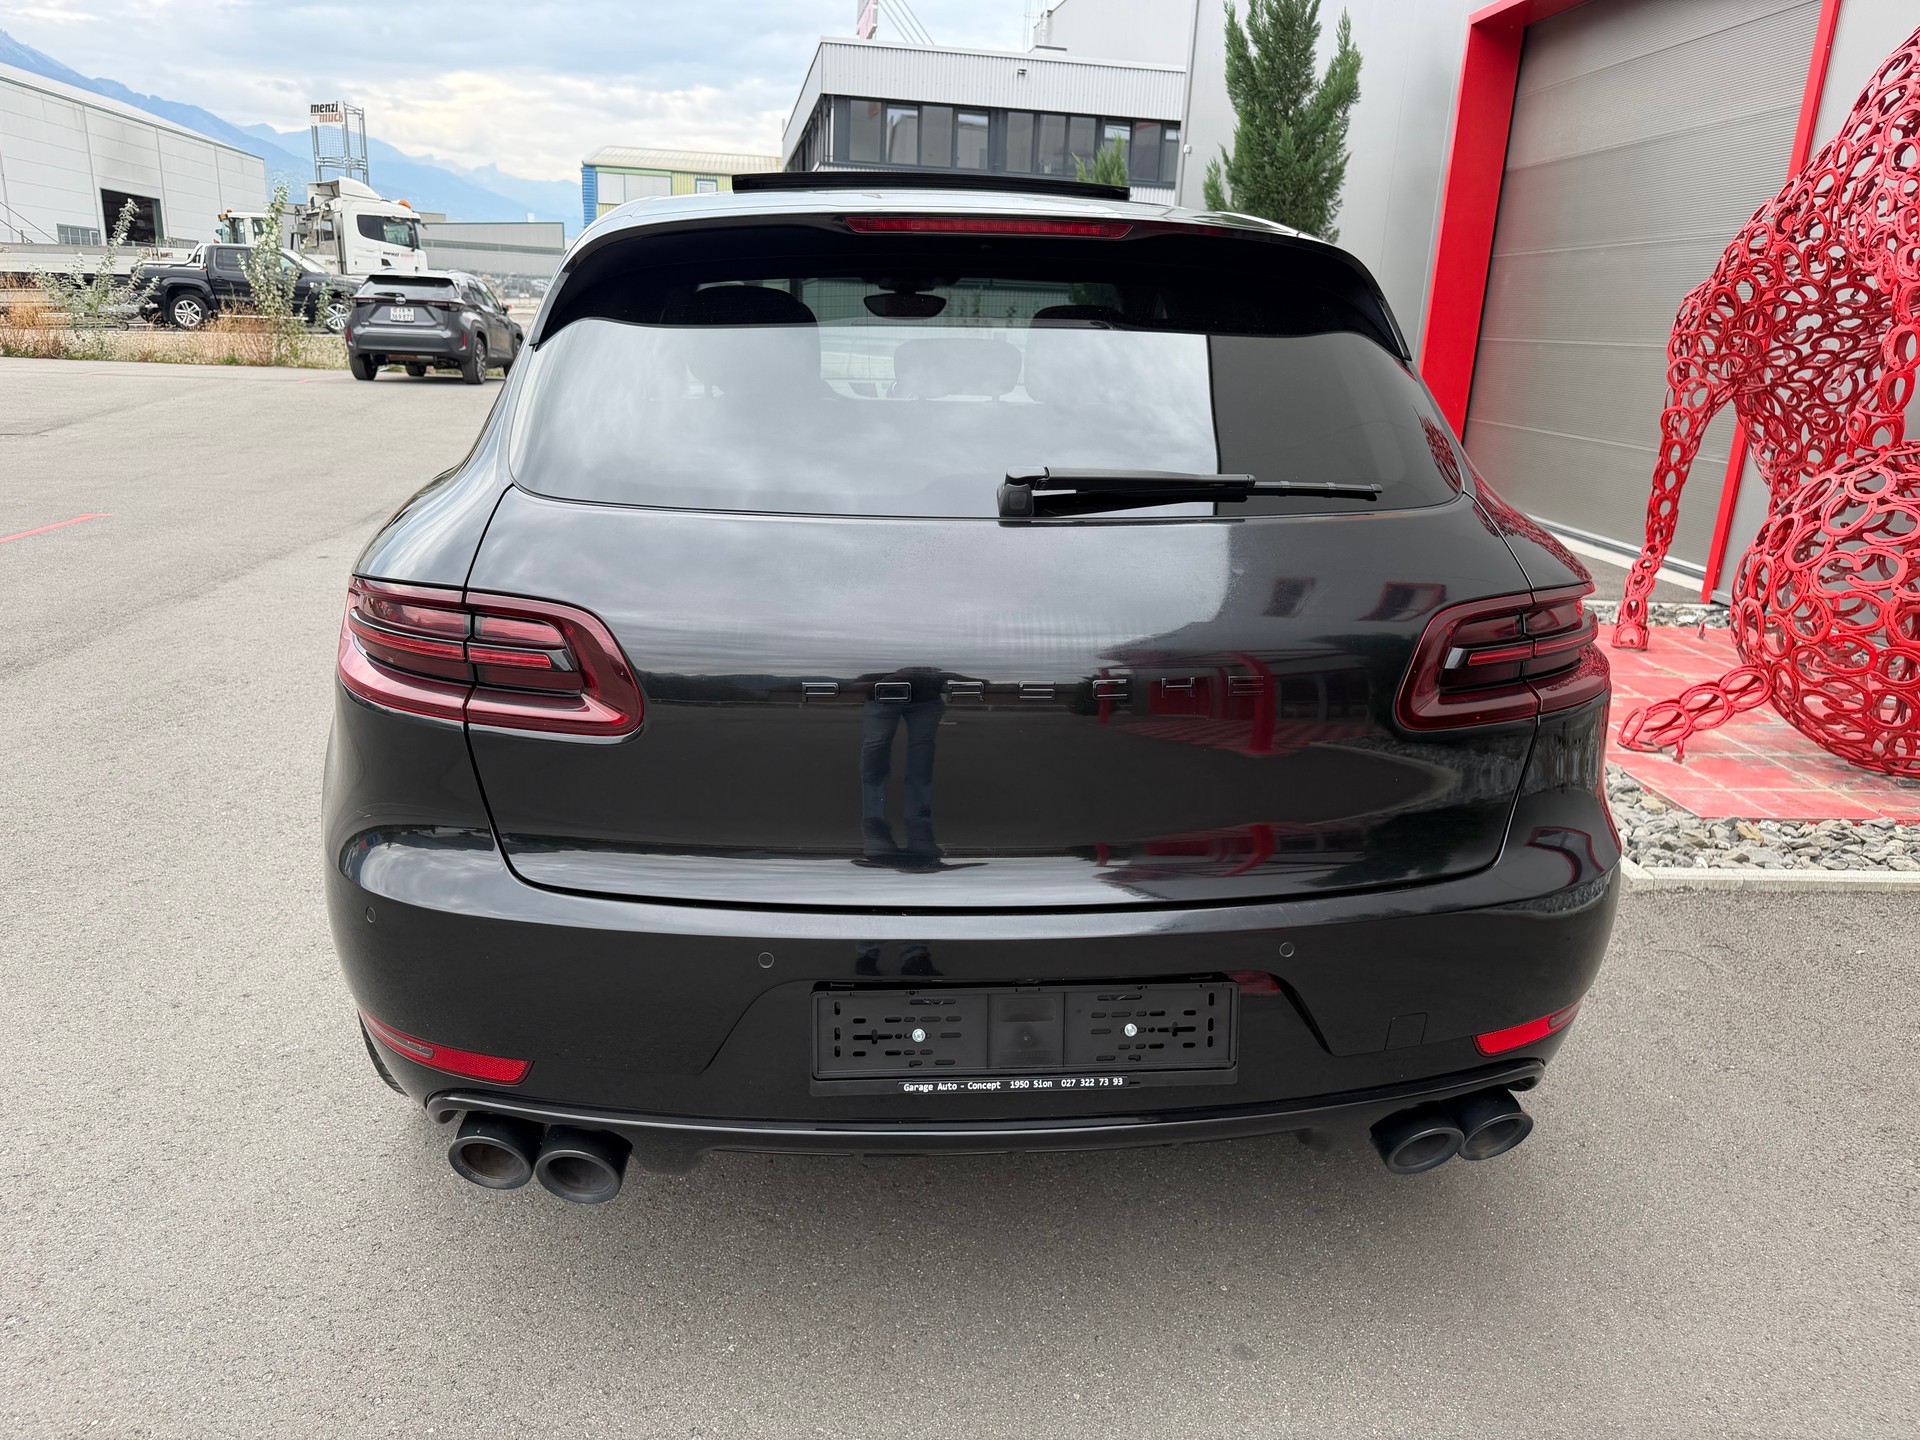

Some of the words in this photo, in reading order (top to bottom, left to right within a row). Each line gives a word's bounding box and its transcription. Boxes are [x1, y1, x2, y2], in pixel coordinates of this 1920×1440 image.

[310, 100, 339, 114] menzi
[319, 110, 344, 123] muck
[801, 675, 1265, 703] PORSCHE
[903, 1083, 934, 1093] Garage
[937, 1082, 958, 1091] Auto
[967, 1081, 1001, 1091] Concept
[1010, 1080, 1030, 1089] 1950
[1033, 1079, 1053, 1088] Sion
[1060, 1079, 1076, 1088] 027
[1080, 1078, 1095, 1087] 322
[1099, 1078, 1109, 1086] 73
[1112, 1077, 1123, 1086] 93
